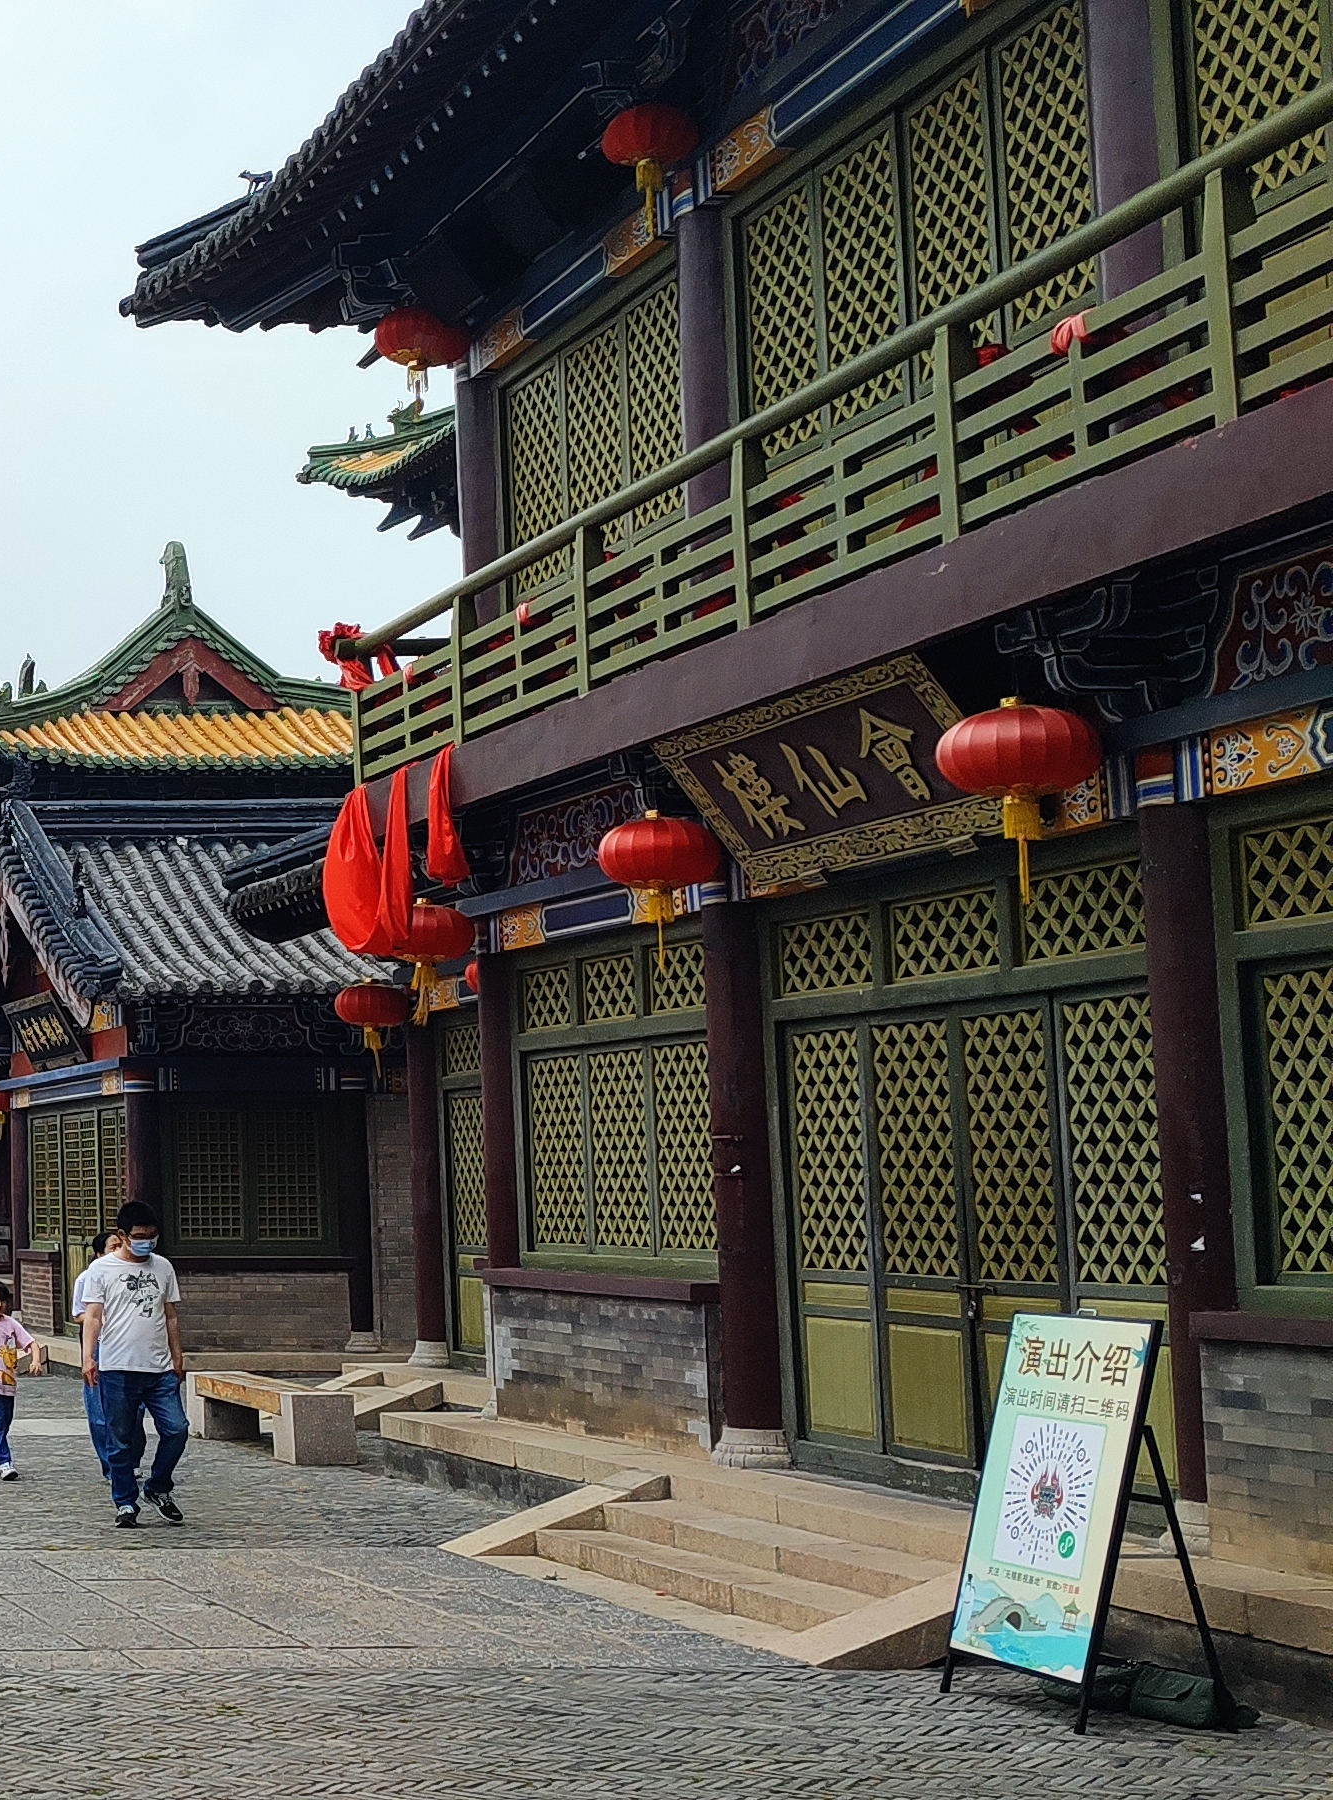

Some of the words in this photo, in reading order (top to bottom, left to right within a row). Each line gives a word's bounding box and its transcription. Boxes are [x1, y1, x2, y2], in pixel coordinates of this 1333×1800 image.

[712, 707, 931, 840] 會仙樓
[1018, 1335, 1132, 1387] 演出介绍
[1002, 1386, 1130, 1422] 演出时间请扫二维码
